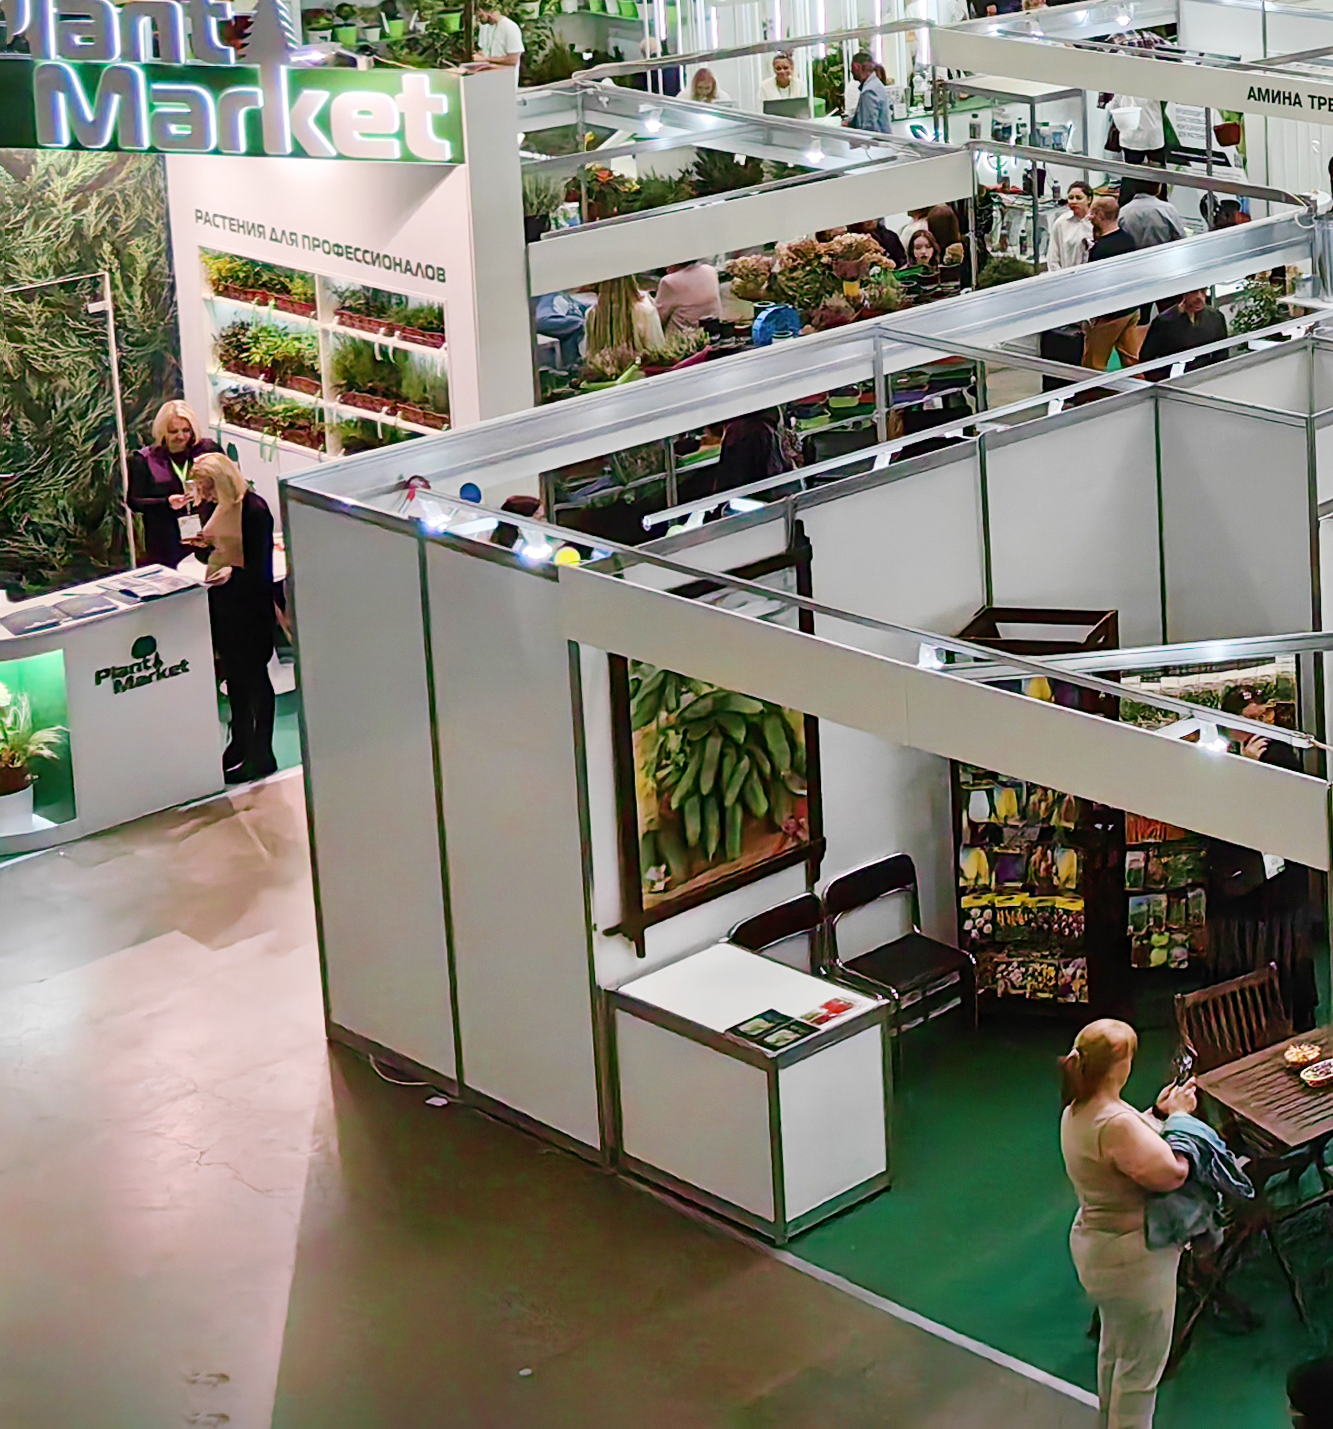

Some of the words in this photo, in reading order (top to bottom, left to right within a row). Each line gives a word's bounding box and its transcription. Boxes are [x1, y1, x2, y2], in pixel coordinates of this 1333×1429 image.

[33, 62, 452, 161] Market
[1246, 85, 1304, 109] АМИНА
[194, 208, 267, 241] РАСТЕНИЯ
[269, 227, 300, 249] ДЛЯ
[301, 234, 448, 284] ПРОФЕССИОНАЛОВ
[113, 658, 191, 695] Market
